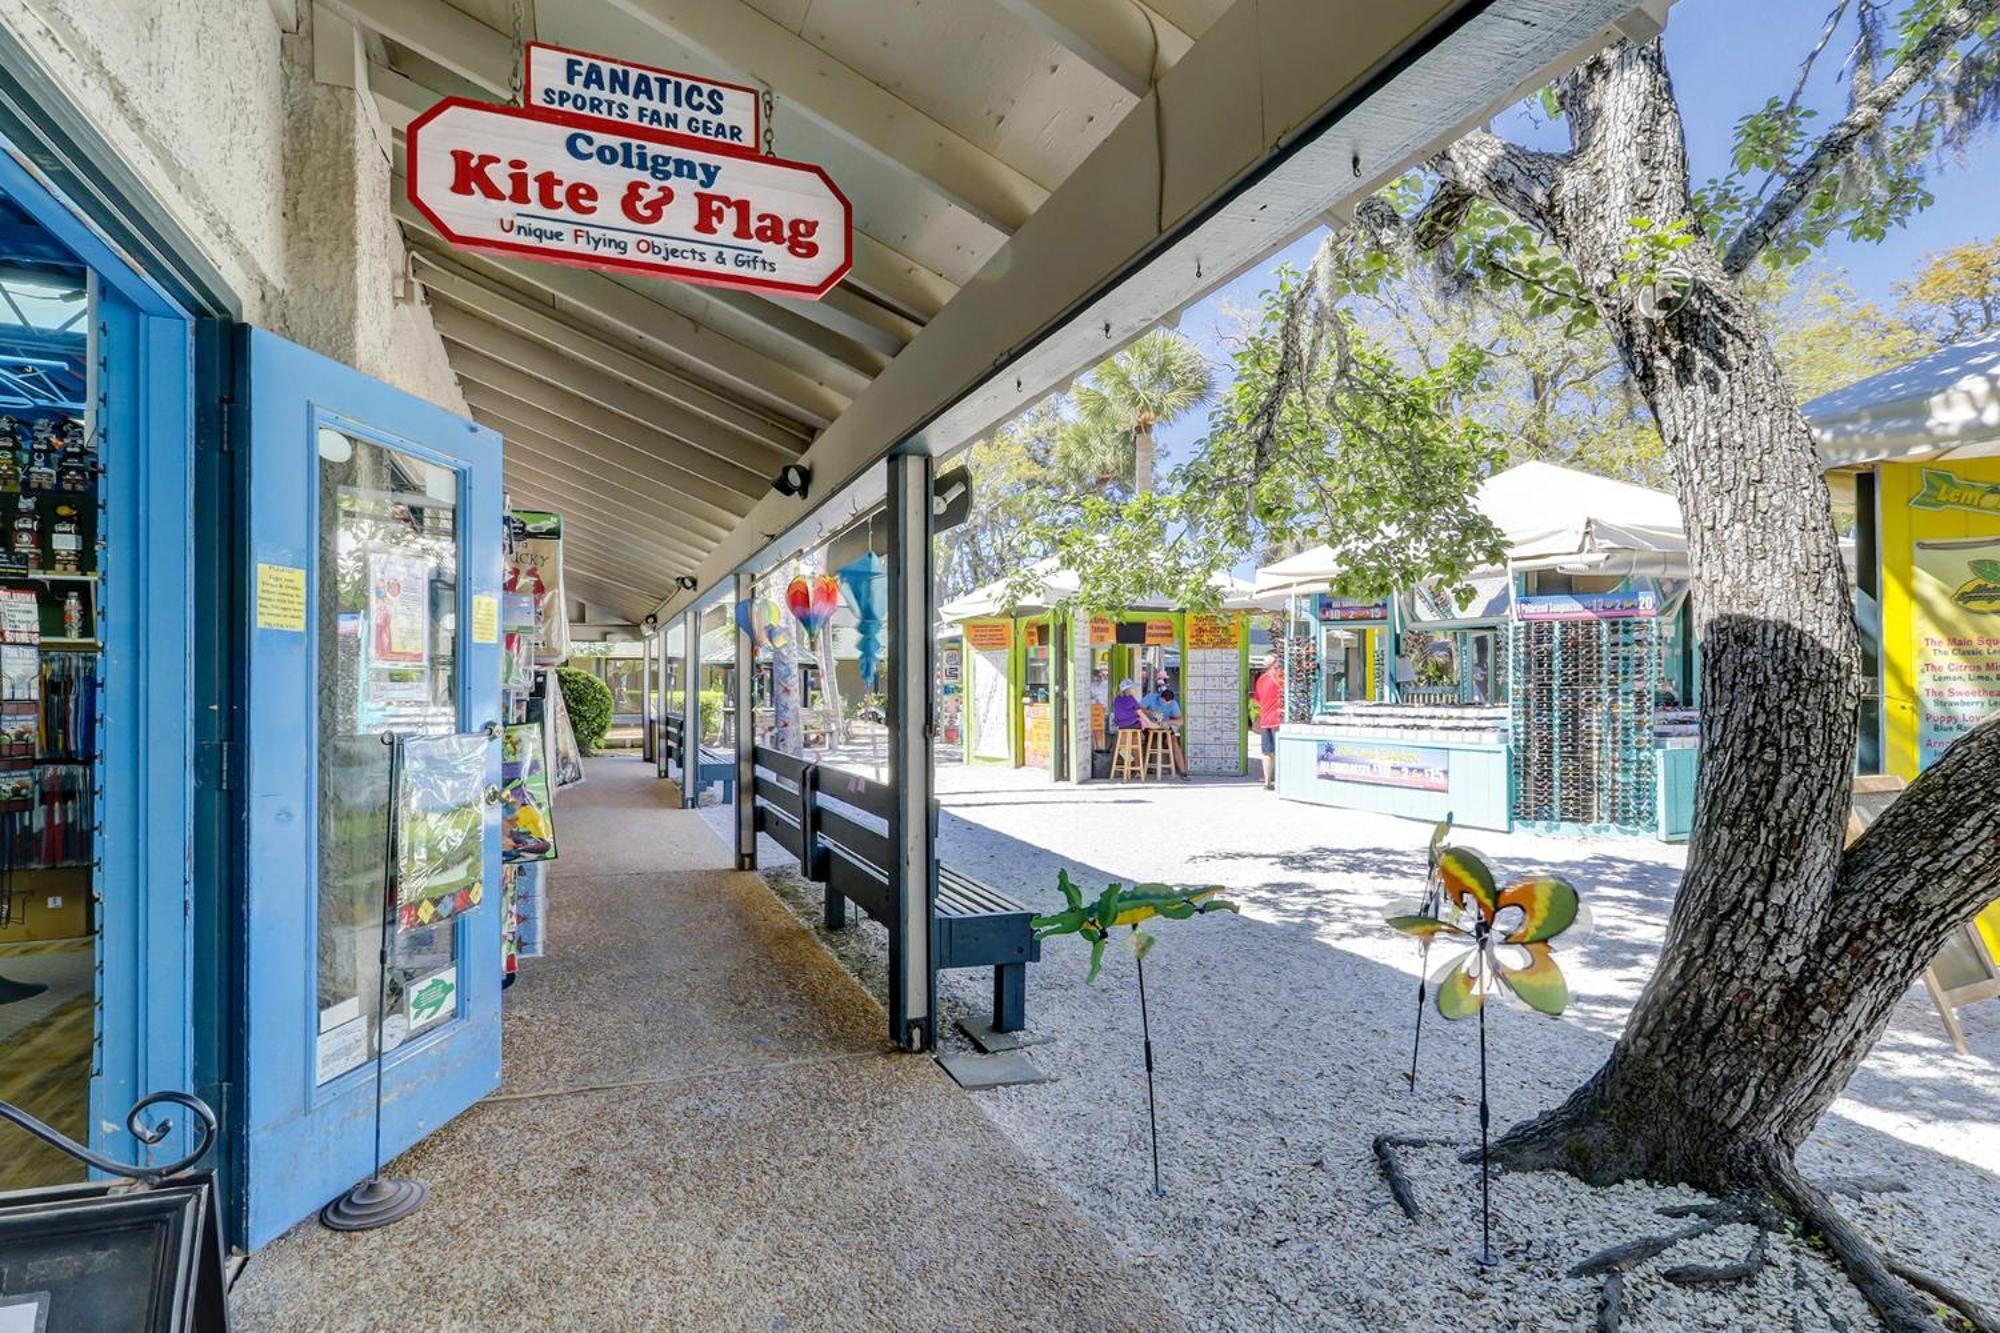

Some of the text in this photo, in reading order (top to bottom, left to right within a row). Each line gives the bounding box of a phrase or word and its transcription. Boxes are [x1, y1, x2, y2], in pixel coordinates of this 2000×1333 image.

[566, 58, 725, 115] FANATICS
[543, 88, 744, 143] SPORTS FAN GEAR
[566, 131, 722, 189] Coligny
[449, 149, 820, 259] Kite & Flag
[499, 218, 777, 273] Unique Flying Objects & Gifts
[1924, 638, 1943, 647] The
[1947, 637, 1973, 647] Main
[1933, 648, 1949, 656] The
[1952, 647, 1984, 656] Classic
[1924, 663, 1943, 673] The
[1947, 663, 1982, 673] Citrus
[1933, 674, 1966, 683] Lemon,
[1925, 688, 1943, 698] The
[1933, 699, 1985, 708] Strawberry
[1926, 713, 1958, 725] Puppy
[1934, 723, 1954, 732] Blue
